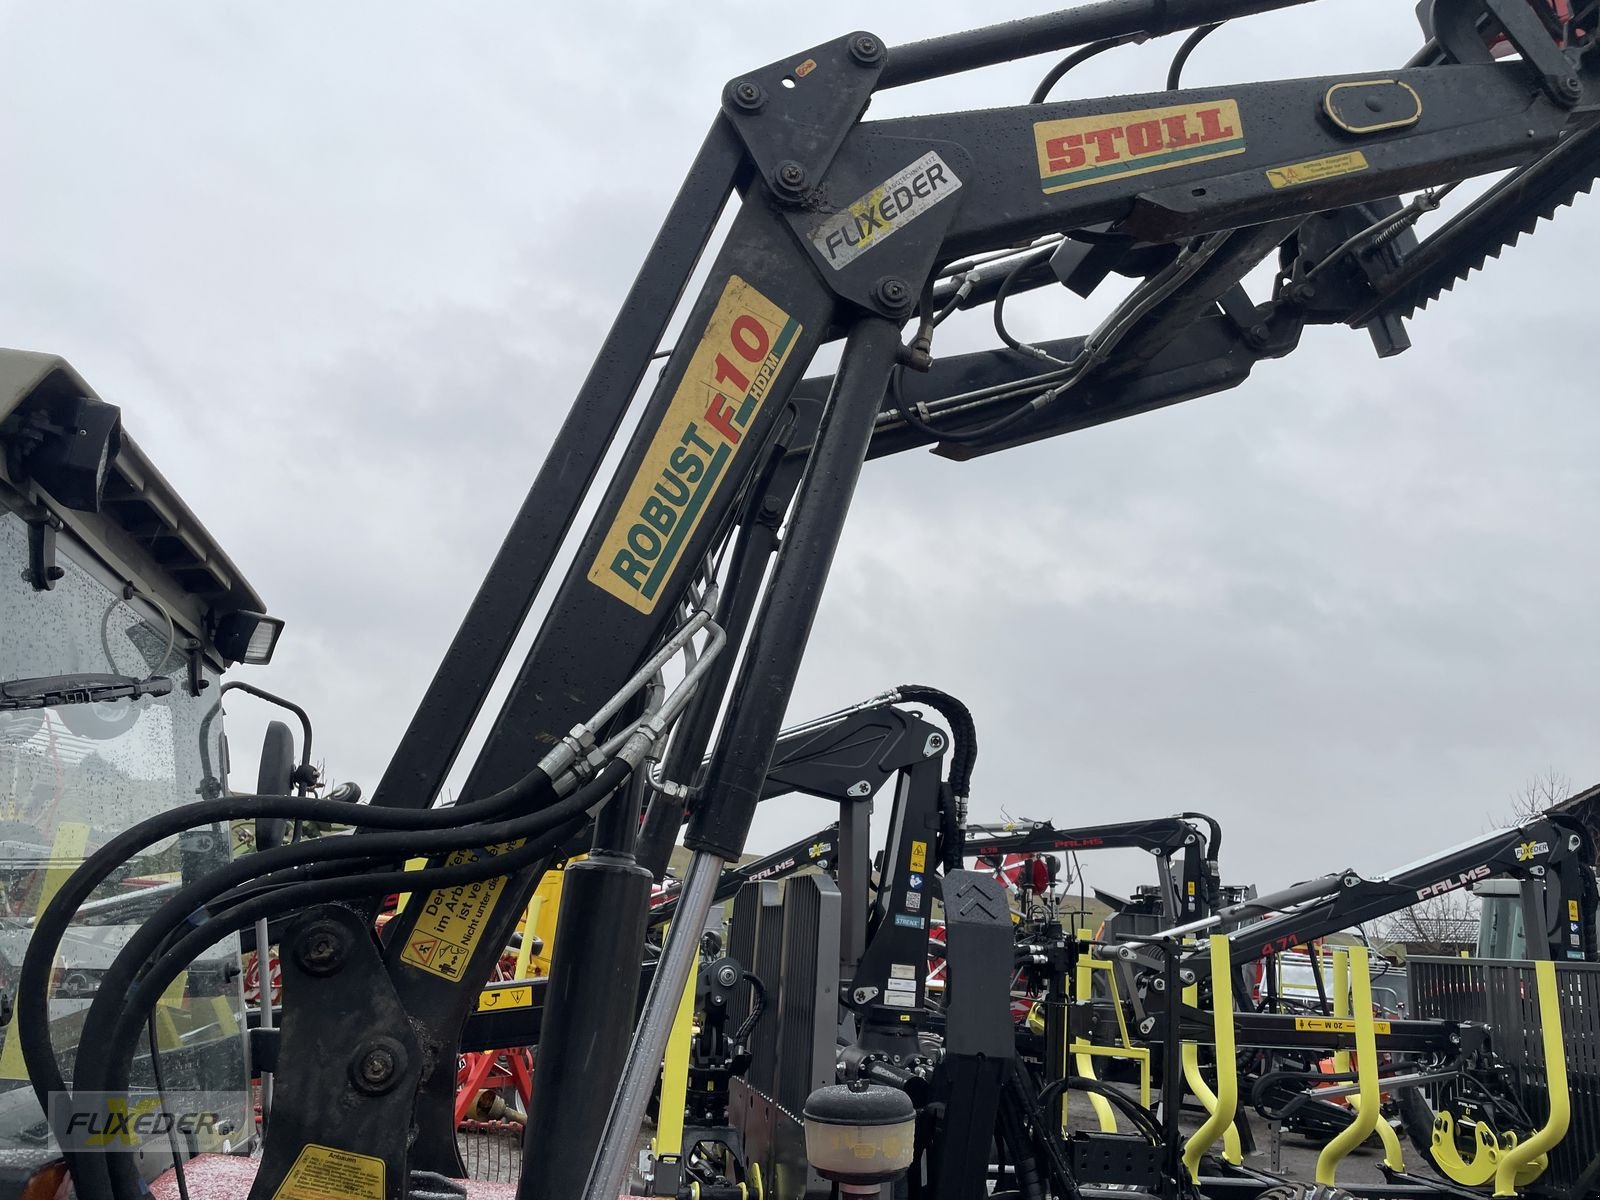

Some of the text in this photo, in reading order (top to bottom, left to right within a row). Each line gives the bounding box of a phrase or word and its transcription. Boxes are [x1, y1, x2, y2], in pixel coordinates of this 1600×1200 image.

[1046, 108, 1234, 172] STOLL
[825, 163, 948, 260] FLIXEDER
[750, 351, 781, 401] HDPM
[609, 314, 770, 592] ROBUST F10
[749, 857, 795, 881] PALMS
[1416, 864, 1491, 901] PALMS
[426, 890, 447, 917] Der
[434, 915, 450, 933] im
[456, 901, 473, 921] ist
[460, 917, 480, 946] Nicht
[476, 892, 492, 919] unter
